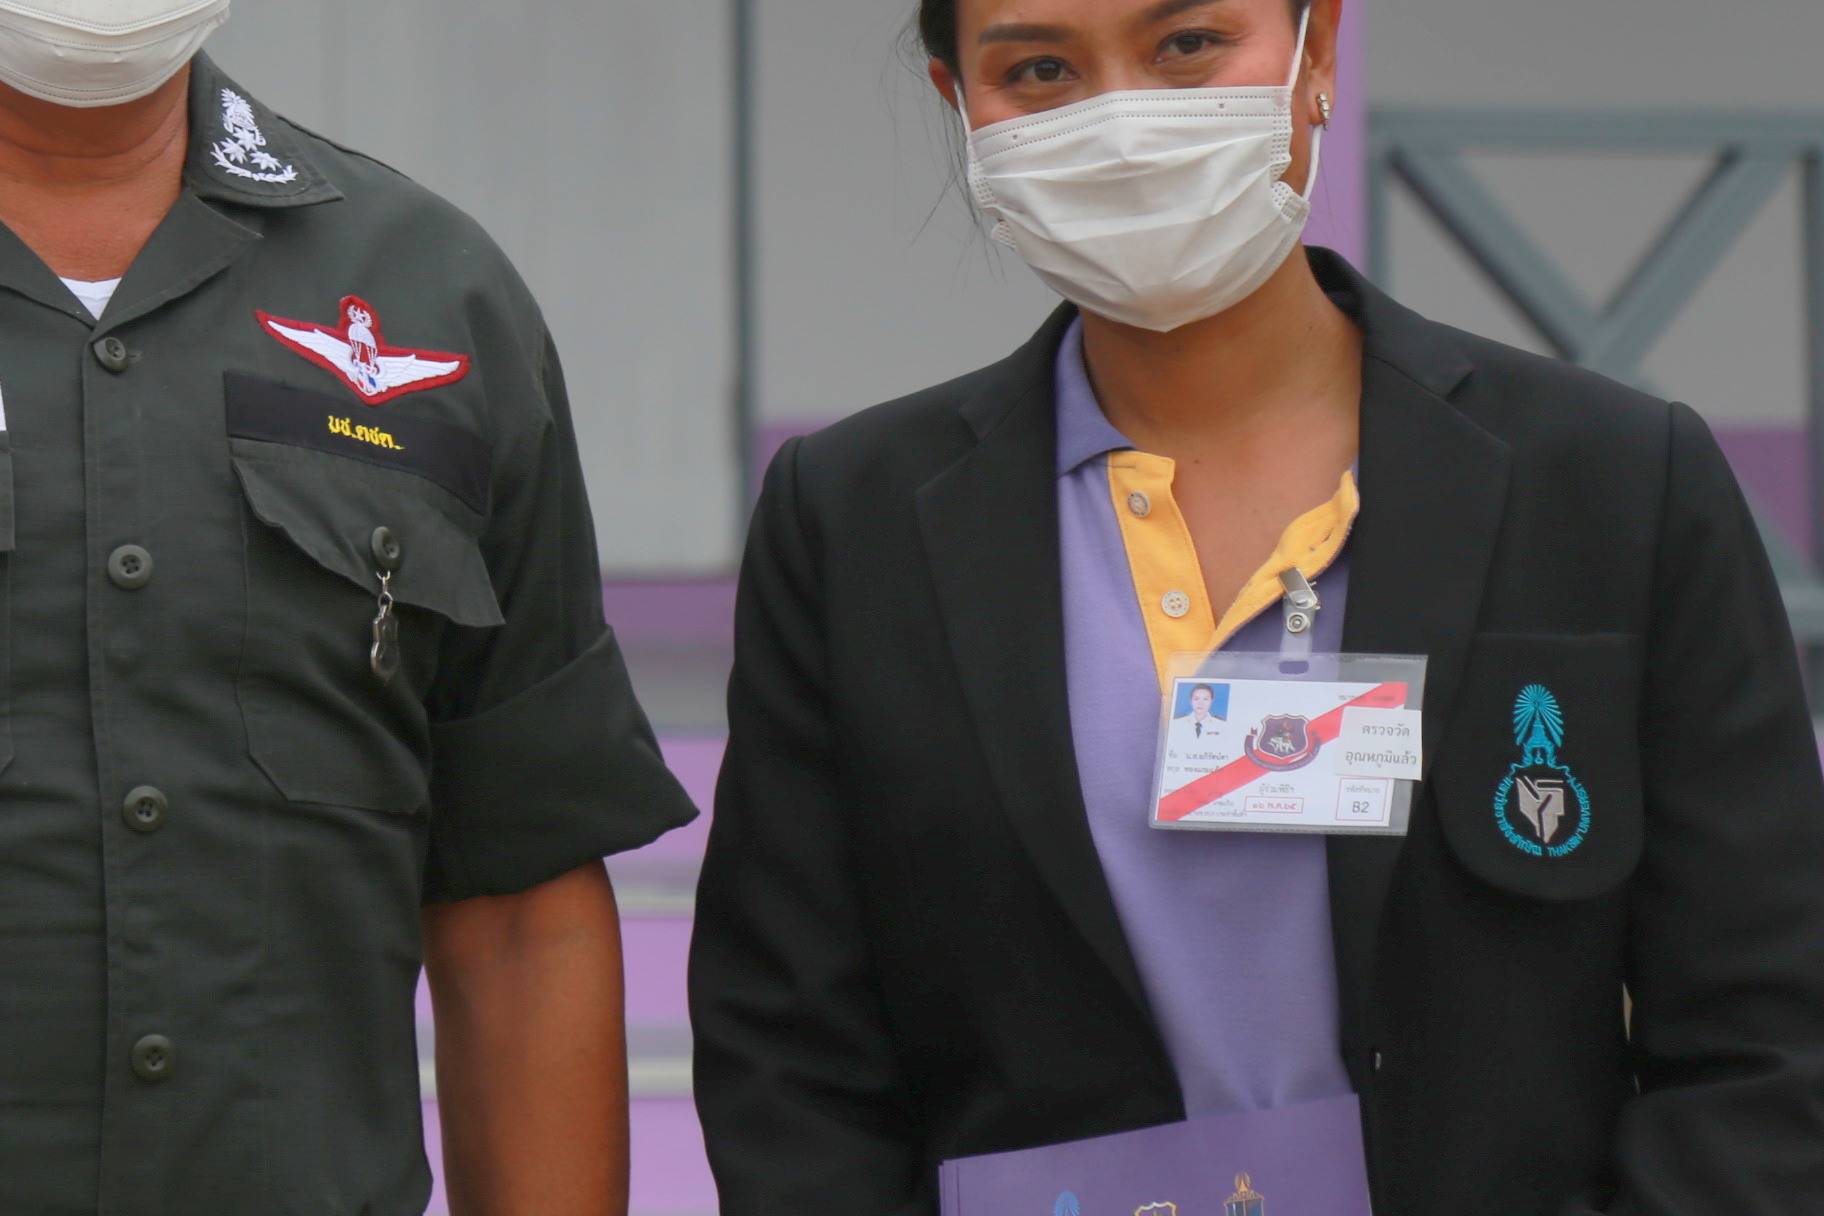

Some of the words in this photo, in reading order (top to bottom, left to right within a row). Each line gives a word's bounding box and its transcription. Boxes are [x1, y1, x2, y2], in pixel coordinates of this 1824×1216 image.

[1362, 722, 1410, 737] ตรวจวัด
[1345, 748, 1417, 768] อุณหภูมิแล้ว
[1352, 800, 1370, 813] B2
[1547, 833, 1584, 857] THAKSIN
[1567, 776, 1592, 834] UNIVERSITY
